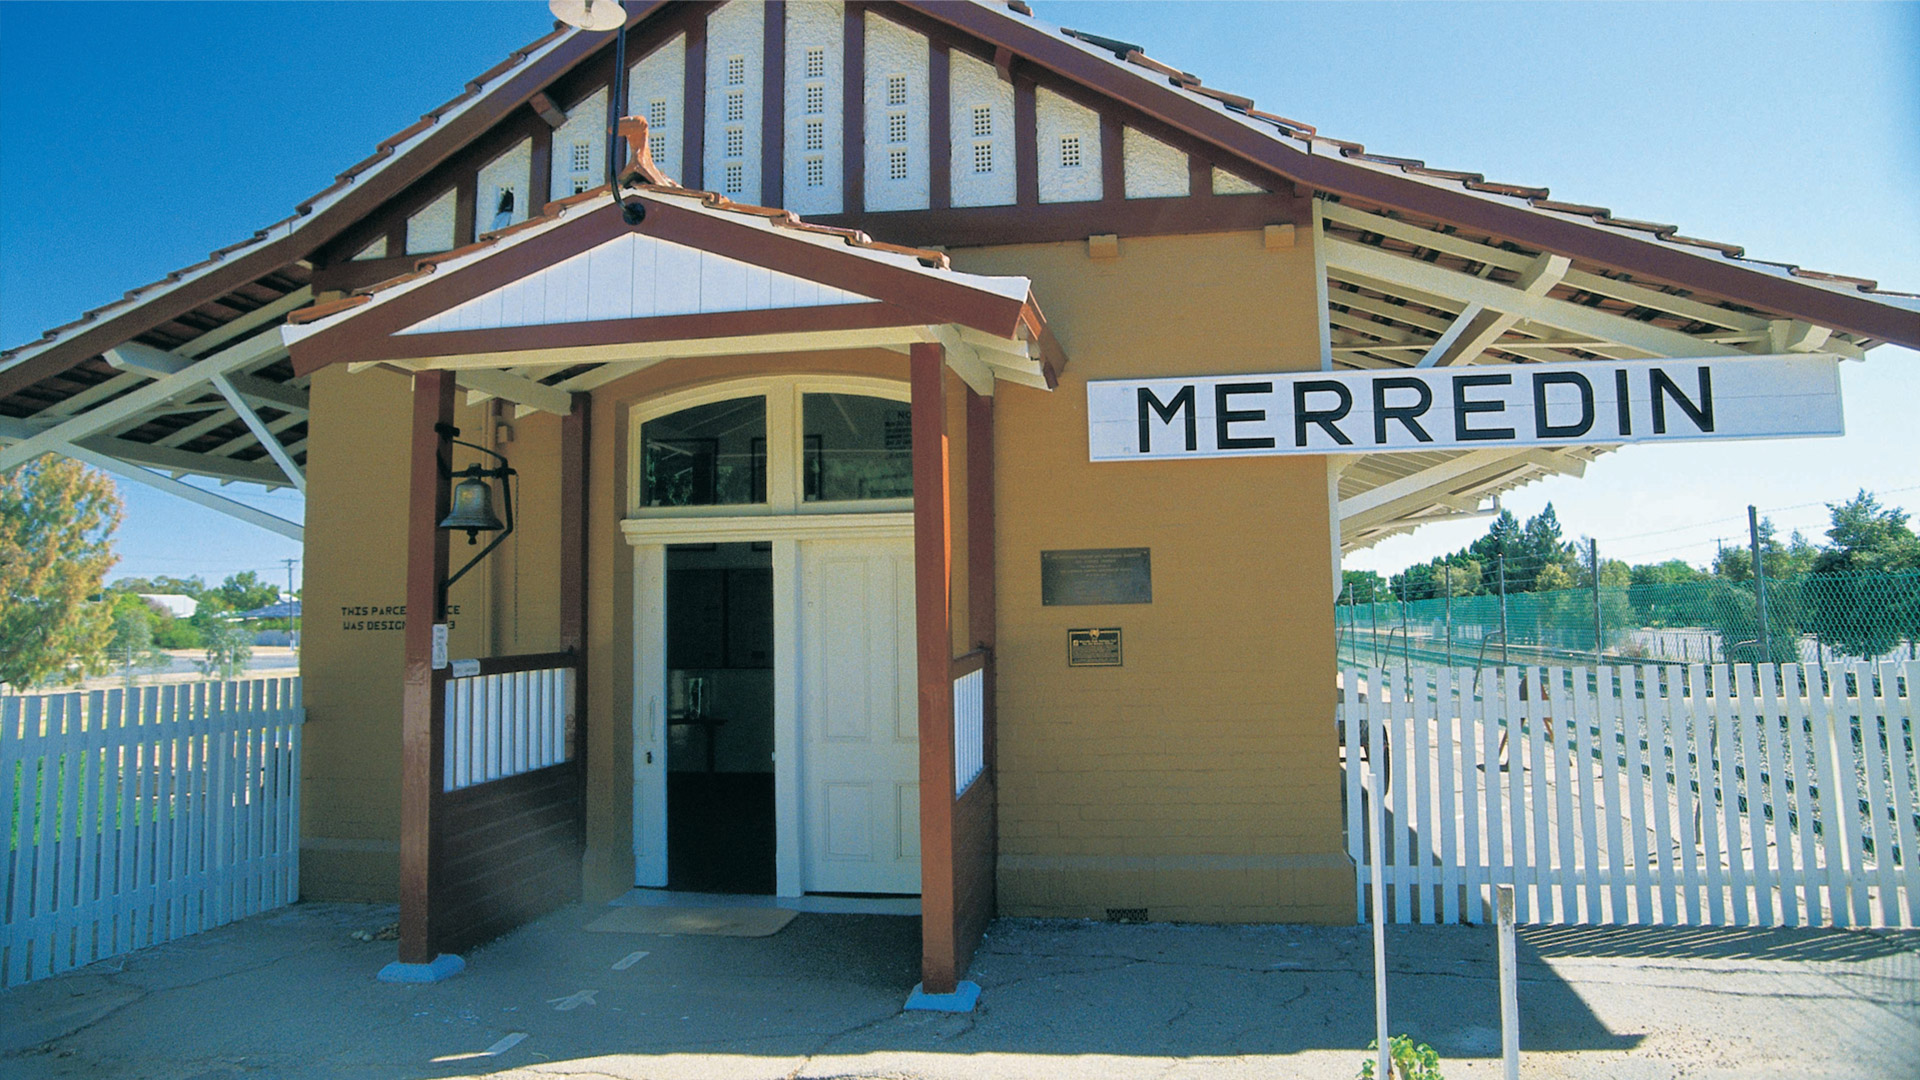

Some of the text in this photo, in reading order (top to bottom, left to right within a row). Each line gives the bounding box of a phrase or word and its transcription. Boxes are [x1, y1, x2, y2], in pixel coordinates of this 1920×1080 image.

[1137, 365, 1715, 453] MERREDIN
[341, 605, 406, 616] THIS PARCE
[343, 621, 364, 630] WAS
